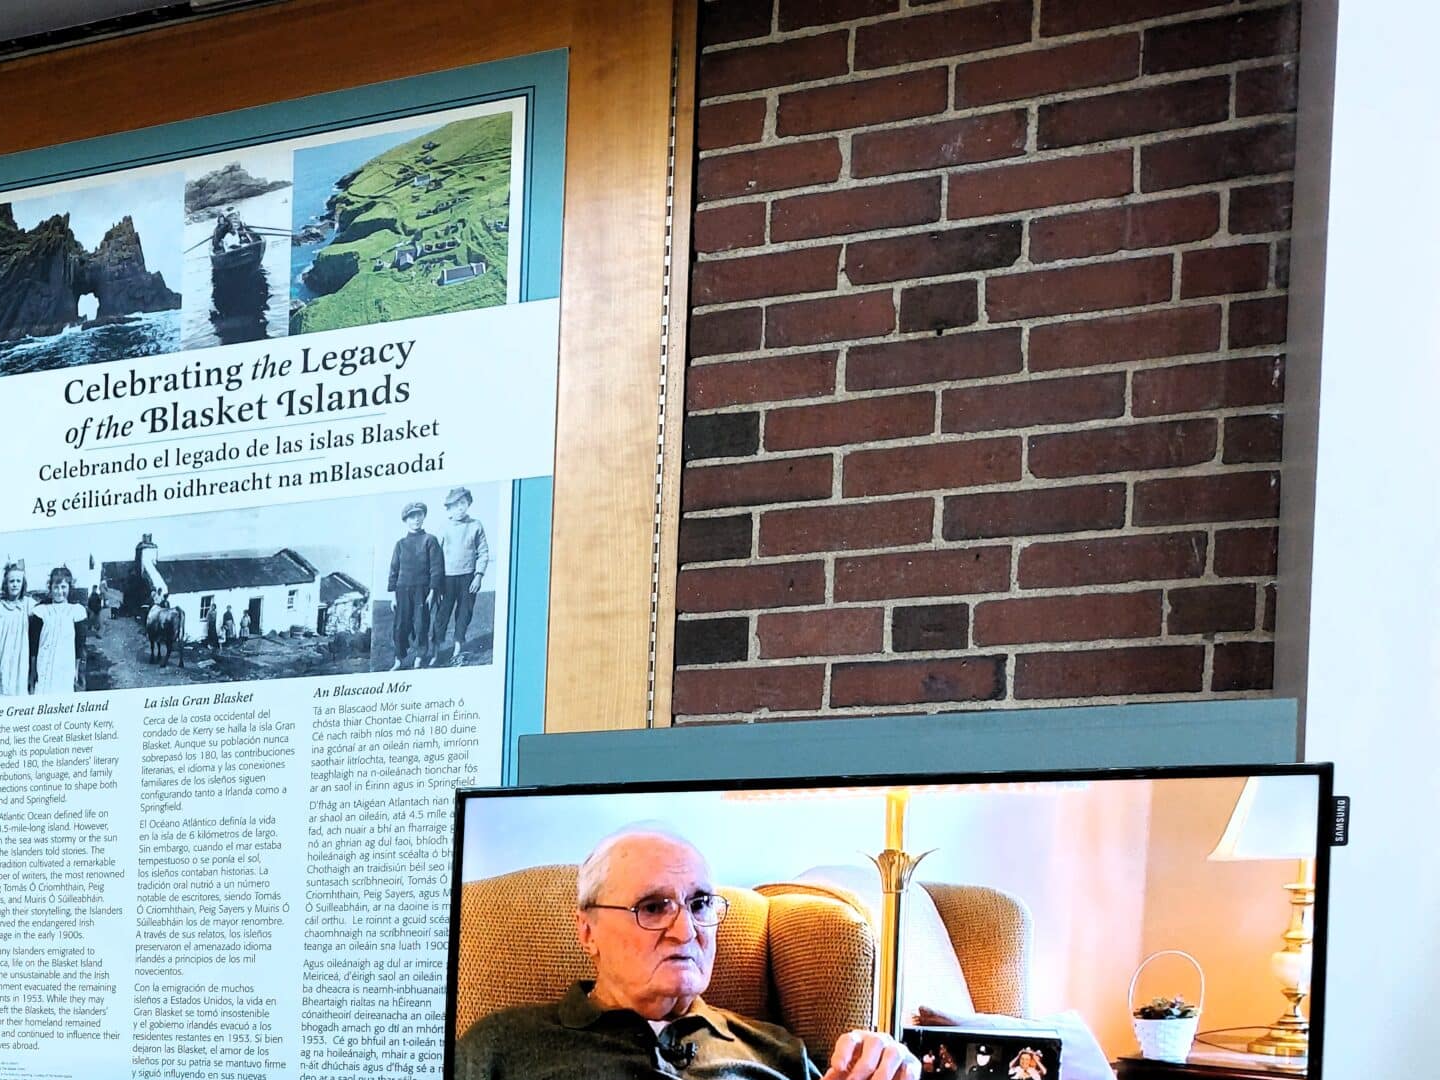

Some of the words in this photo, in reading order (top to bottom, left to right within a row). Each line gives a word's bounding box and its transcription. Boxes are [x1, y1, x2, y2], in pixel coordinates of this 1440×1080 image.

[64, 358, 243, 405] Celebrating
[251, 348, 292, 380] the
[300, 340, 416, 379] Legacy
[64, 411, 94, 452] of
[95, 408, 134, 440] the
[140, 392, 268, 434] Blasket
[276, 375, 410, 417] Islands
[38, 450, 147, 481] Celebrando
[153, 446, 168, 468] el
[175, 439, 240, 471] legado
[246, 436, 269, 458] de
[276, 433, 302, 454] las
[309, 427, 354, 451] islas
[361, 417, 439, 444] Blasket
[32, 492, 56, 520] Ag
[61, 480, 157, 511] céiliúradh
[163, 468, 272, 500] oidhreacht
[278, 472, 302, 487] na
[309, 449, 444, 484] mBlascaodaí
[313, 687, 329, 698] An
[332, 683, 384, 697] Blascaod
[386, 681, 412, 693] Mór
[6, 705, 35, 716] Great
[36, 703, 74, 715] Blasket
[76, 700, 109, 713] Island
[143, 697, 157, 708] La
[160, 696, 179, 707] isla
[182, 695, 210, 706] Gran
[212, 692, 253, 704] Blasket
[312, 705, 322, 716] Tá
[324, 707, 336, 715] an
[338, 702, 377, 714] Blascaod
[379, 701, 398, 711] Mór
[400, 699, 422, 710] suite
[424, 697, 455, 709] amach
[457, 696, 464, 707] ó
[142, 715, 165, 726] Cerca
[167, 714, 178, 724] de
[180, 713, 188, 724] la
[189, 713, 211, 723] costa
[213, 709, 255, 721] occidental
[257, 708, 270, 719] del
[11, 723, 30, 732] west
[31, 722, 52, 731] coast
[53, 720, 62, 730] of
[63, 720, 91, 732] County
[142, 726, 178, 738] condado
[179, 725, 191, 736] de
[192, 725, 214, 737] Kerry
[215, 726, 225, 734] se
[227, 722, 247, 733] halla
[249, 722, 256, 732] la
[258, 721, 272, 731] isla
[273, 720, 296, 731] Gran
[13, 735, 26, 745] lies
[28, 734, 40, 744] the
[42, 733, 63, 743] Great
[65, 731, 92, 742] Blasket
[19, 746, 27, 756] its
[29, 745, 69, 759] population
[71, 746, 93, 754] never
[41, 757, 54, 767] the
[93, 755, 119, 767] literary
[72, 768, 87, 778] and
[89, 767, 112, 779] family
[29, 781, 62, 792] continue
[64, 781, 72, 790] to
[73, 780, 97, 792] shape
[99, 778, 117, 789] both
[9, 794, 24, 804] and
[1335, 799, 1346, 842] SAMSUNG
